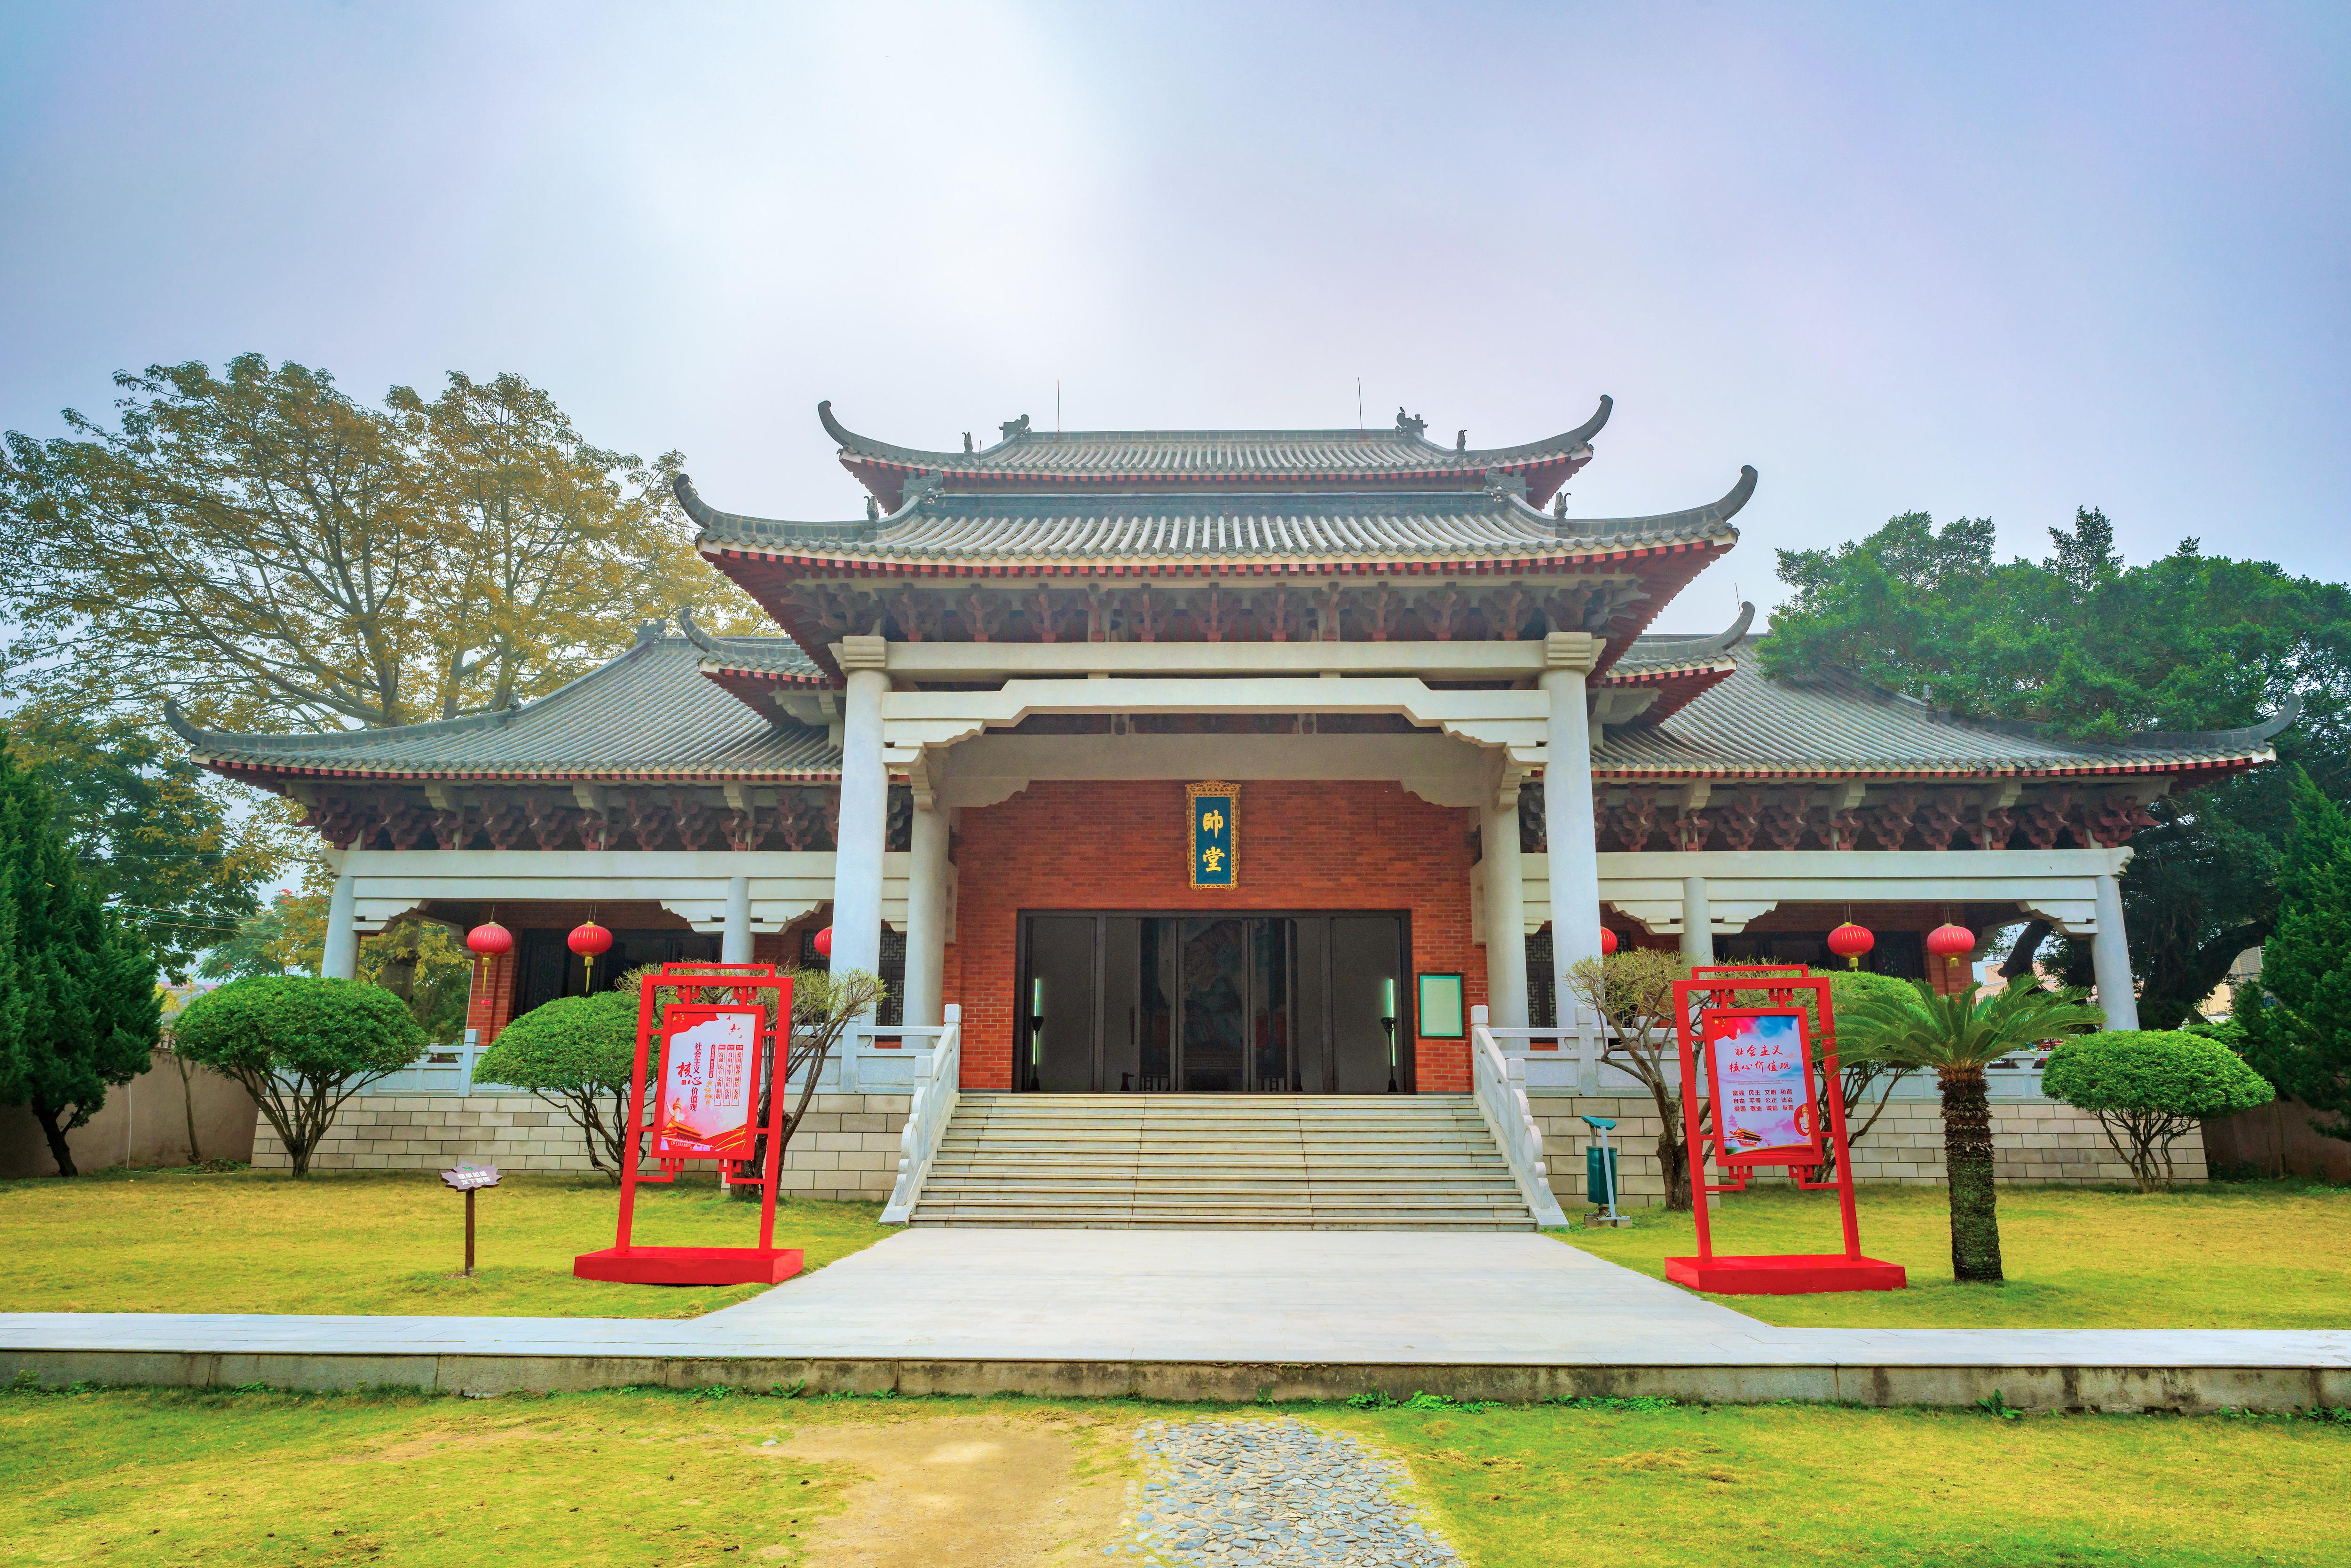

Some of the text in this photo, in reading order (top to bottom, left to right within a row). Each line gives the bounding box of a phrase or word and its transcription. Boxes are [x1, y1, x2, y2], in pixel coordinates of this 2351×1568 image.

[1203, 809, 1225, 872] 帥堂
[693, 1042, 702, 1074] 社会主义
[1735, 1044, 1783, 1057] 社会主义
[676, 1061, 702, 1085] 核心
[716, 1052, 724, 1099] 富强 民主 文明 和谐
[725, 1052, 733, 1099] 自由 平等 公正 法治
[734, 1052, 742, 1099] 爱国 敬业 诚信 友善
[1728, 1060, 1791, 1073] 核心价值观
[690, 1087, 699, 1111] 价值观
[461, 1176, 491, 1185] 足下留情
